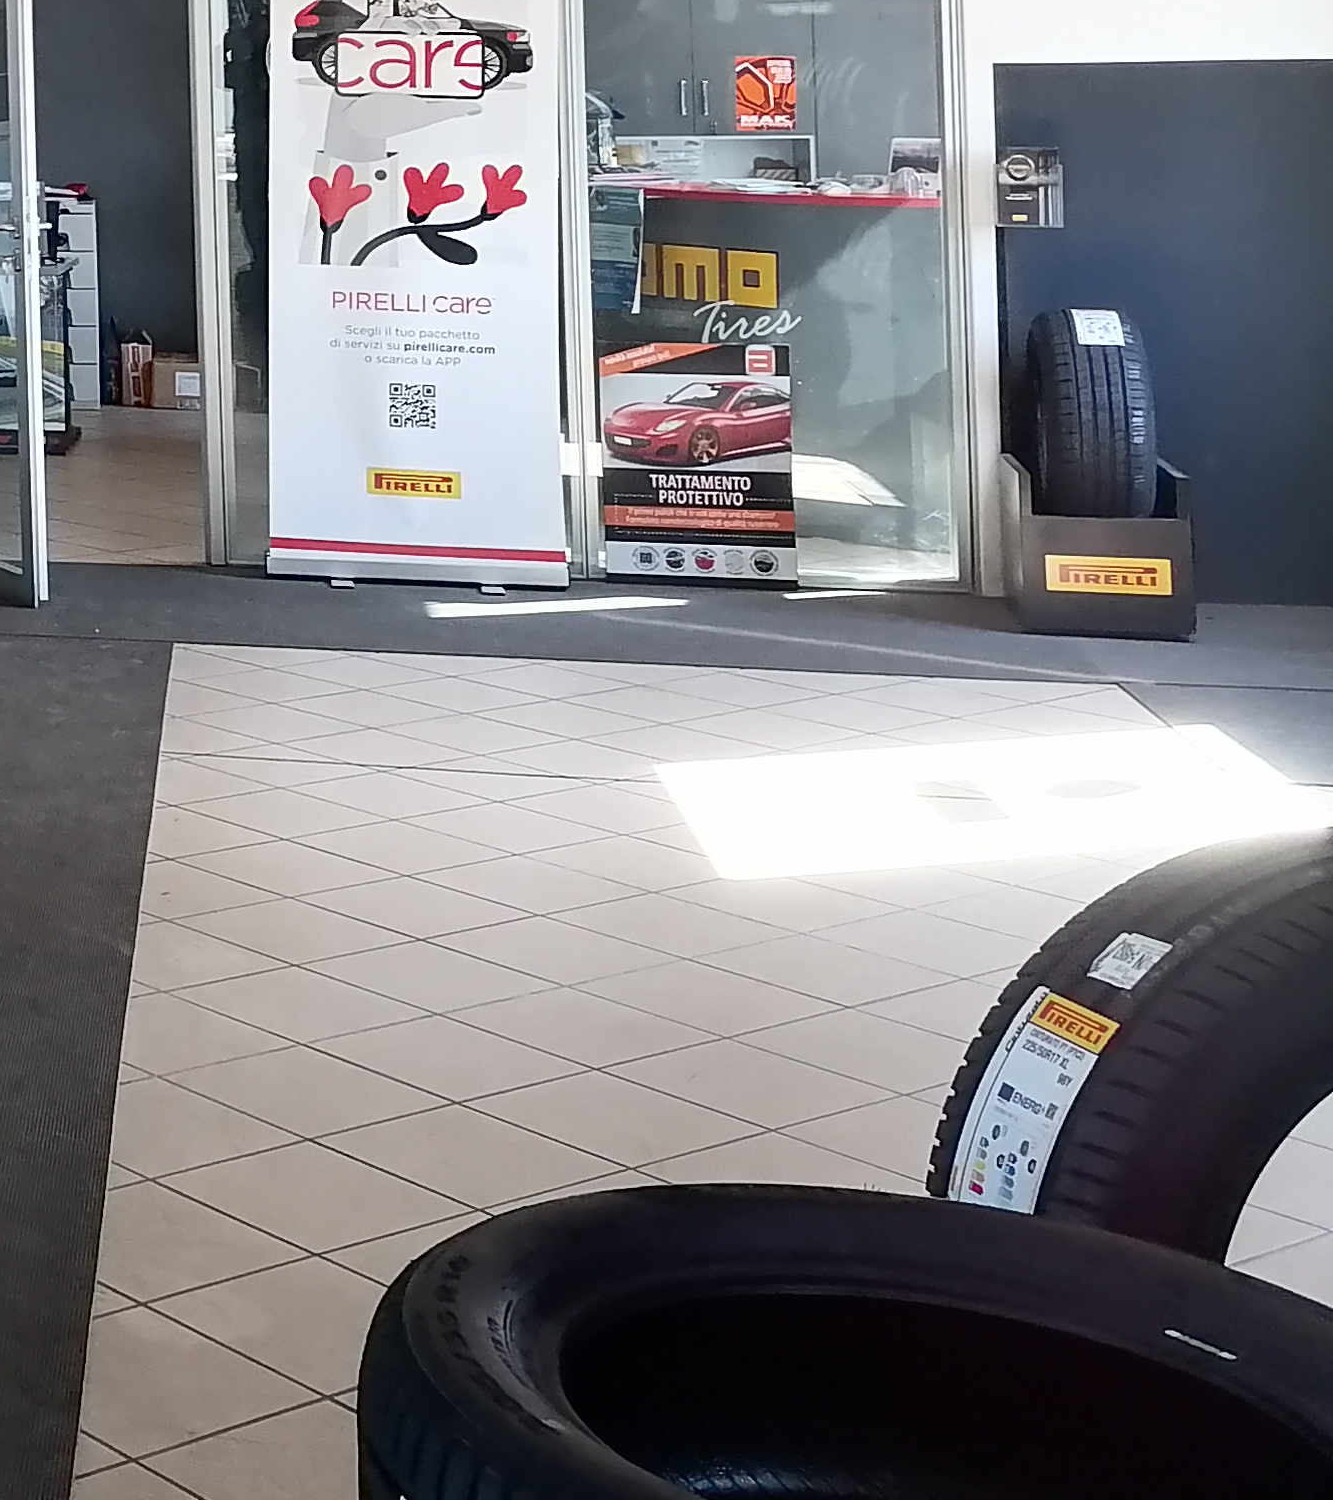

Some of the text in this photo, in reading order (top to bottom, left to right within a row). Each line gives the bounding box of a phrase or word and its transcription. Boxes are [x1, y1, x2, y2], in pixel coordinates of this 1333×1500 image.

[332, 291, 493, 315] PIRELLI care
[693, 300, 802, 344] Tires
[345, 325, 481, 340] Scegli il tuo pacchetto
[329, 338, 496, 355] di servizi su pirellicare.com
[364, 354, 462, 367] o scarica la APP
[374, 473, 454, 493] PIRELLI
[649, 473, 752, 491] TRATTAMENTO
[658, 489, 744, 507] PROTETTIVO
[1059, 564, 1158, 587] PIRELLI
[1038, 999, 1109, 1045] PIRELLI
